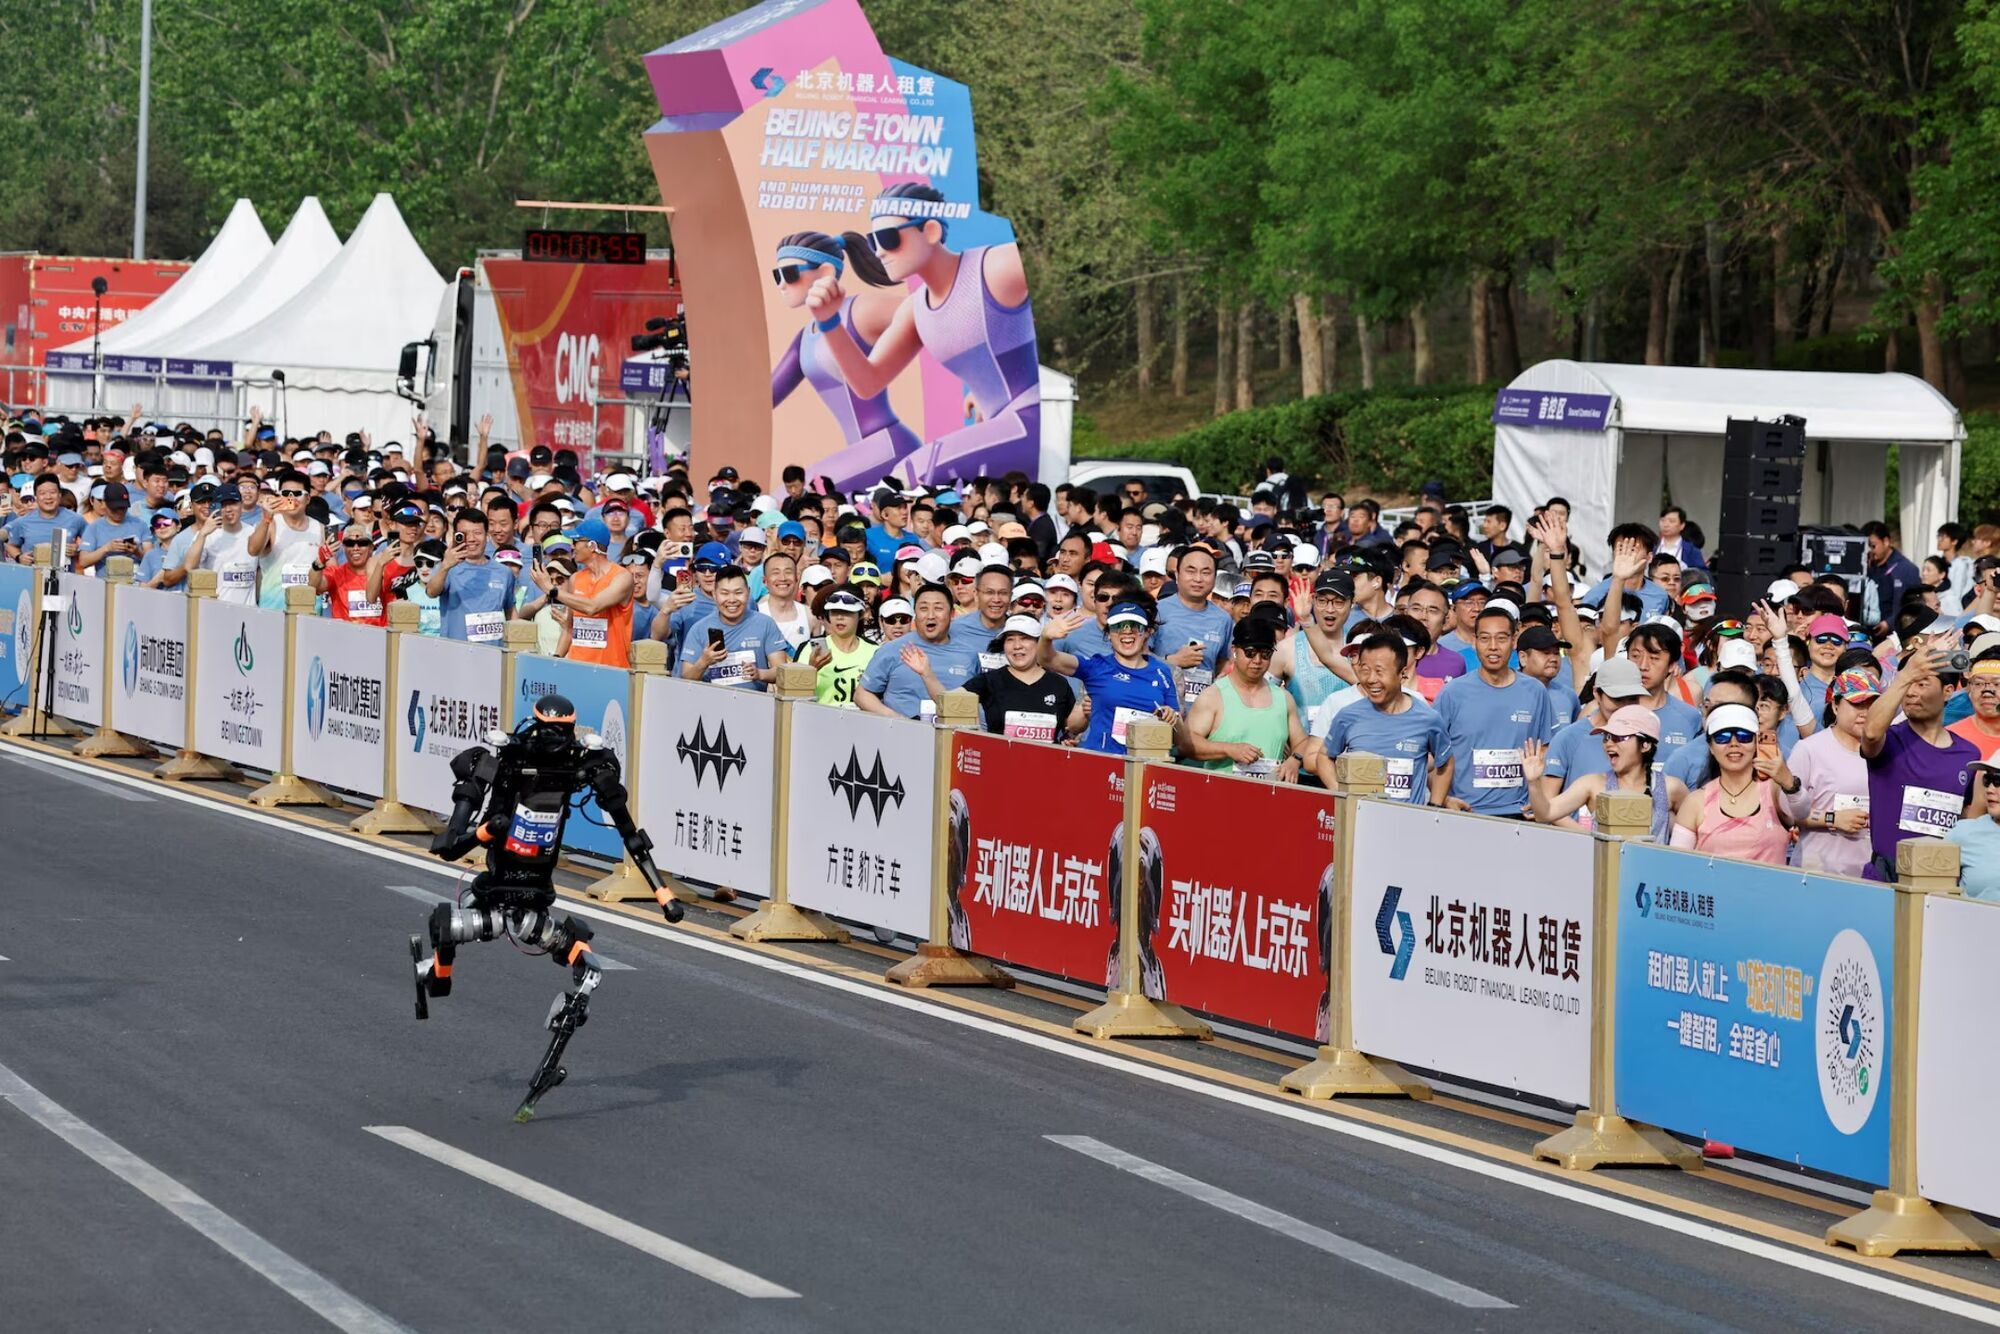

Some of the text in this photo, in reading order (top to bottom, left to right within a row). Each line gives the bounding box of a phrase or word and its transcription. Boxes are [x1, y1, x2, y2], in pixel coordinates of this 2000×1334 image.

[796, 70, 935, 96] 北京机器人租赁
[765, 107, 944, 145] BEIJING E-TOWN
[760, 138, 953, 177] HALF MARATHON
[758, 181, 864, 196] AND HUMANOID
[758, 194, 971, 218] ROBOT HALF MARATHON
[555, 331, 600, 406] CMG
[576, 629, 605, 641] B10023
[329, 671, 381, 720] 尚亦城集团
[1016, 726, 1053, 739] C25181
[1486, 765, 1521, 778] C10401
[675, 809, 742, 860] 方程豹汽车
[1917, 808, 1958, 828] C14560
[827, 844, 901, 899] 方程豹汽车
[973, 837, 1102, 928] 买机器人上京东
[1655, 886, 1714, 918] 北京机器人租赁
[1168, 878, 1312, 978] 买机器人上京东
[1425, 895, 1582, 984] 北京机器人租赁
[1425, 967, 1451, 988] BEIJING
[1453, 973, 1478, 993] ROBOT
[1481, 979, 1517, 1002] FINANCIAL
[1519, 987, 1550, 1009] LEASING
[1647, 949, 1729, 1003] 租机器人就上
